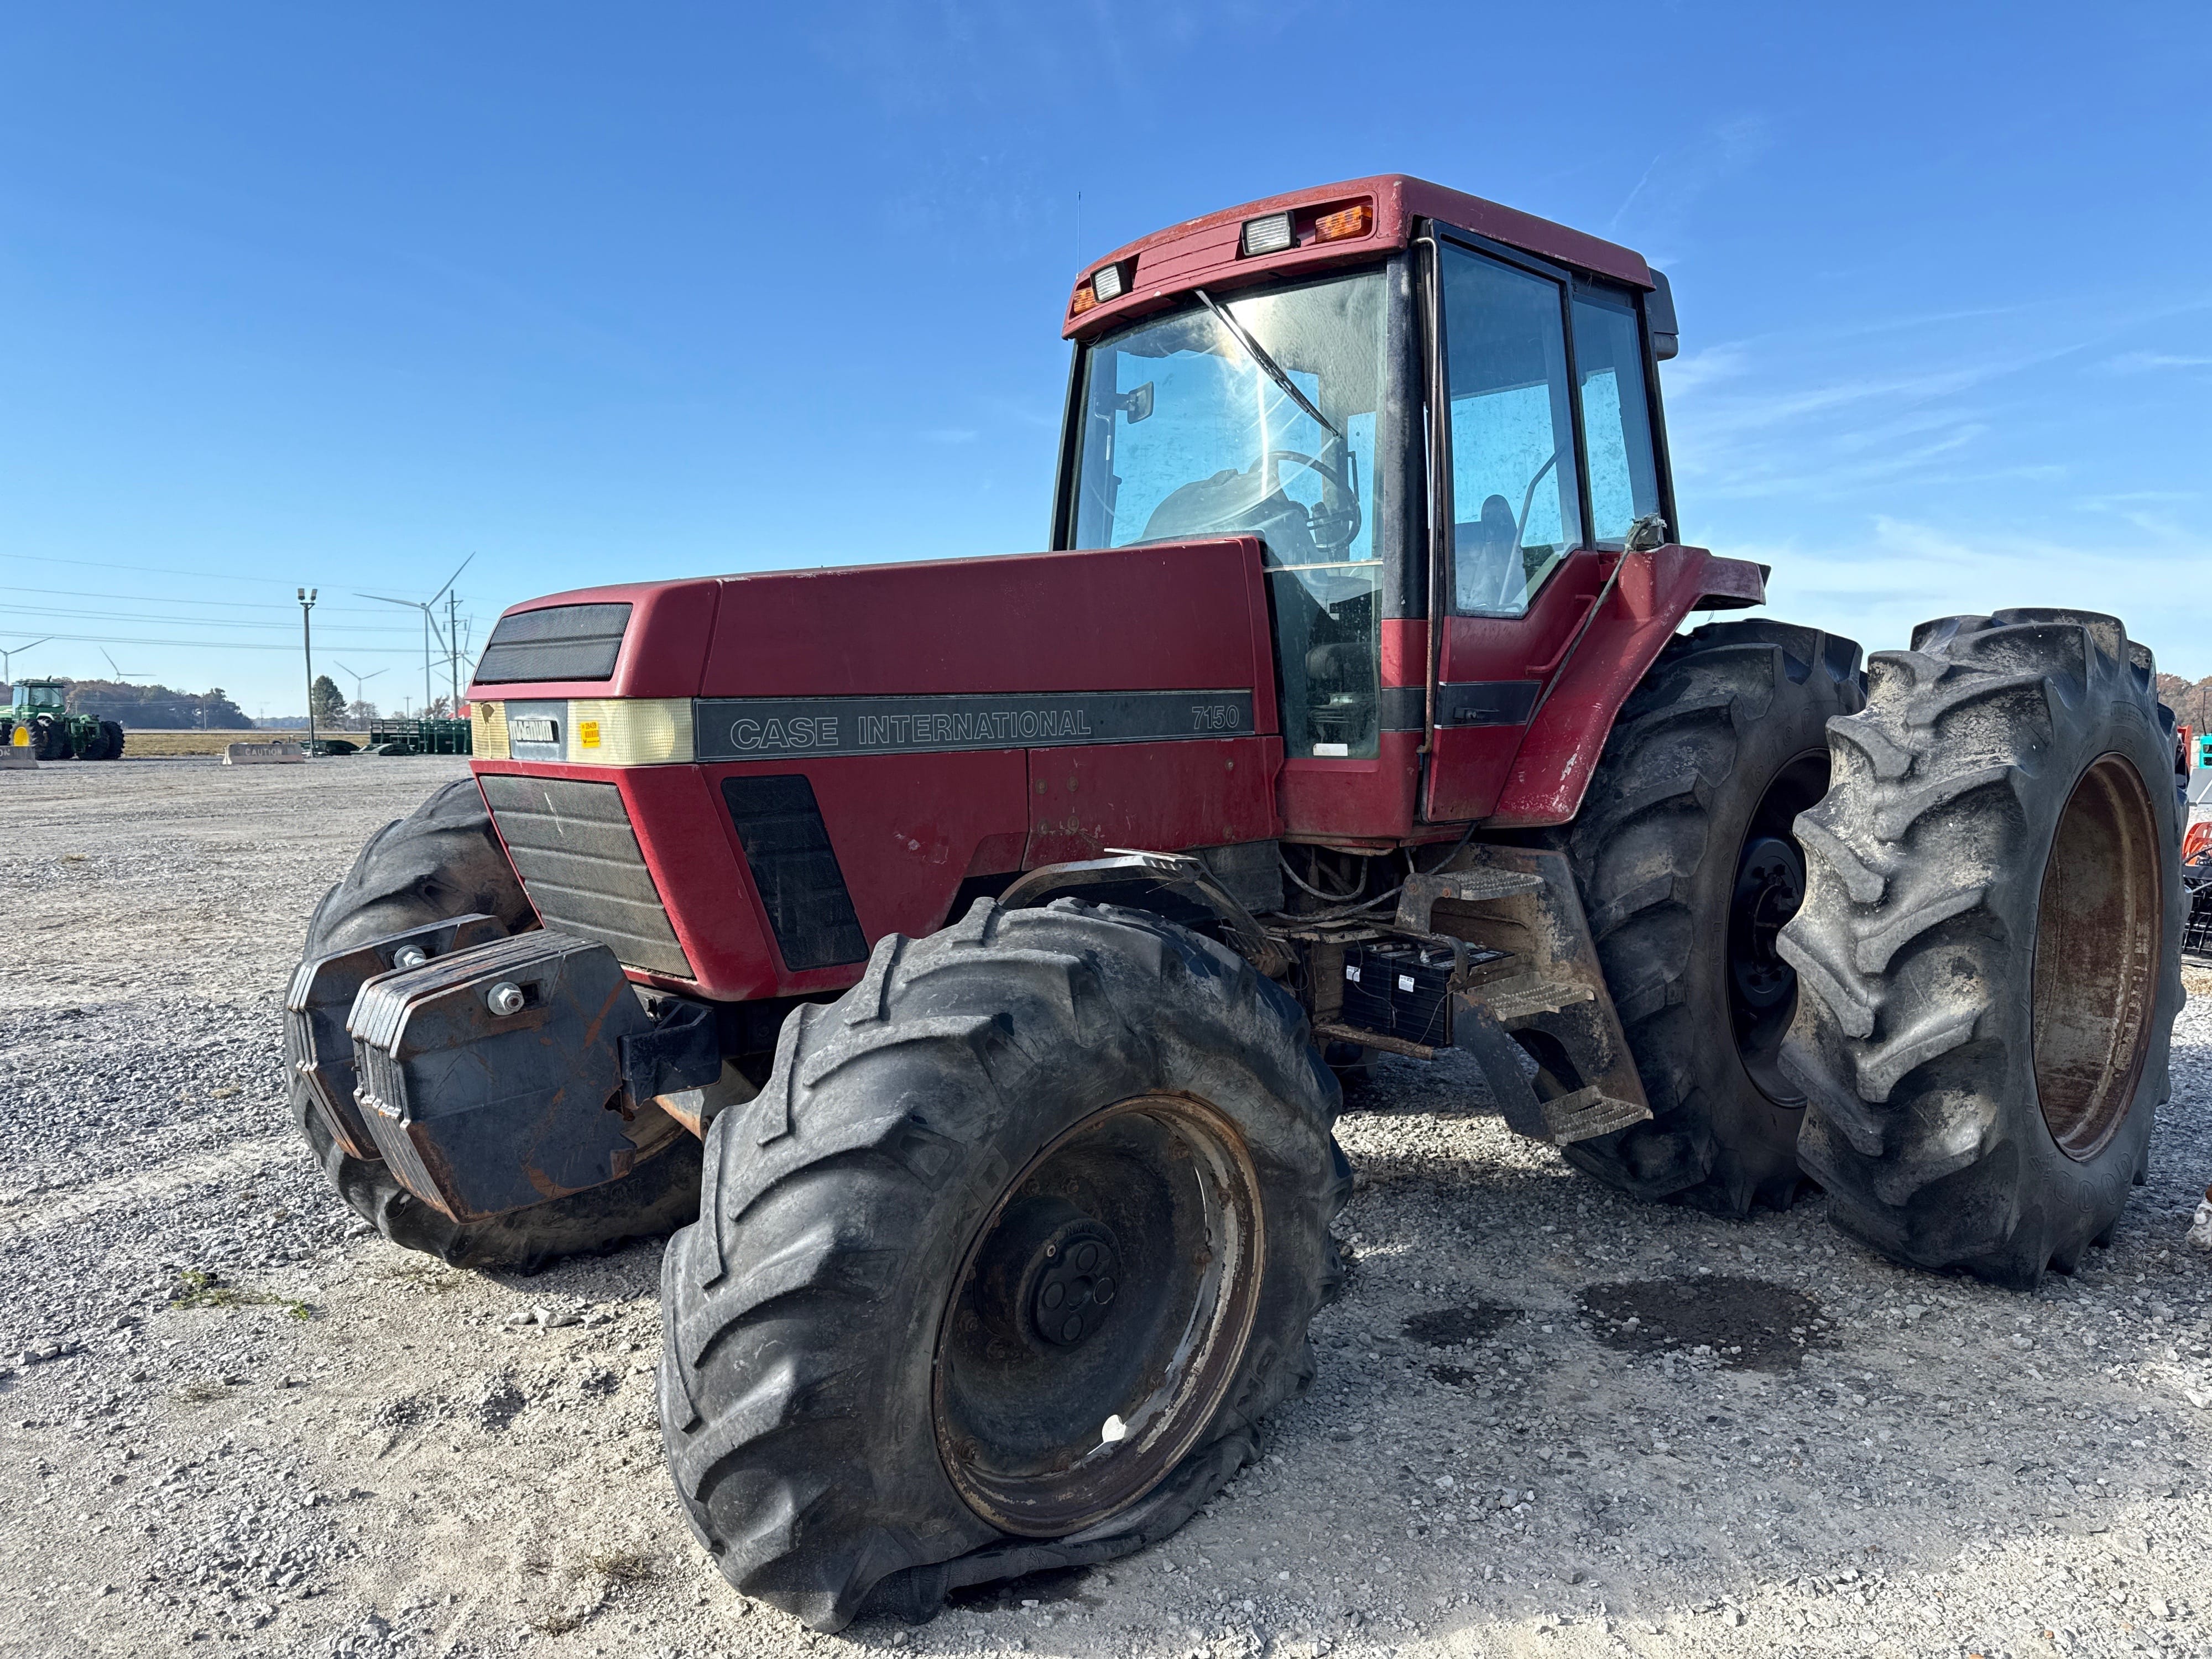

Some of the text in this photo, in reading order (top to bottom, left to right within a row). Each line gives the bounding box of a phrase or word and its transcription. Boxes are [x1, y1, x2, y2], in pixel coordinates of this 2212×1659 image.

[509, 721, 554, 741] MAGNUM
[730, 705, 1239, 749] CASE INTERNATIONAL 7150
